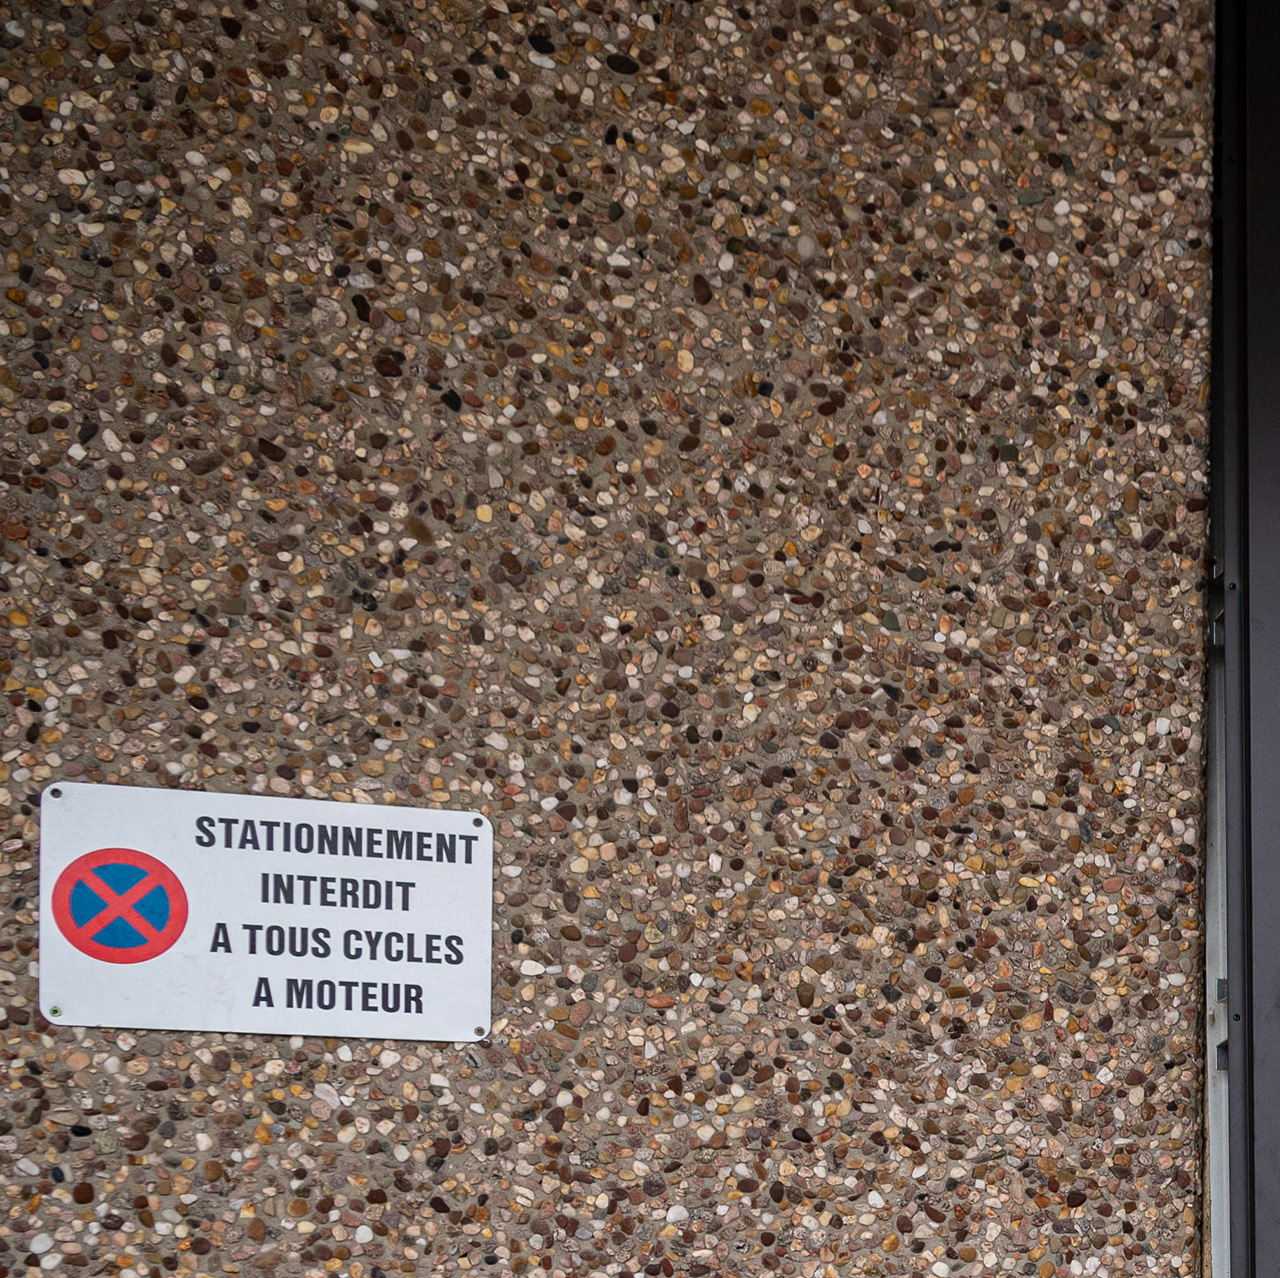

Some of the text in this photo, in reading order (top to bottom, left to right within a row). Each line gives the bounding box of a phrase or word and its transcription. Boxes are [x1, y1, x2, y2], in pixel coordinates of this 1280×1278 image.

[194, 815, 479, 865] STATIONNEMENT
[260, 873, 416, 911] INTERDIT
[210, 922, 464, 965] A TOUS CYCLES
[252, 977, 424, 1014] A MOTEUR
